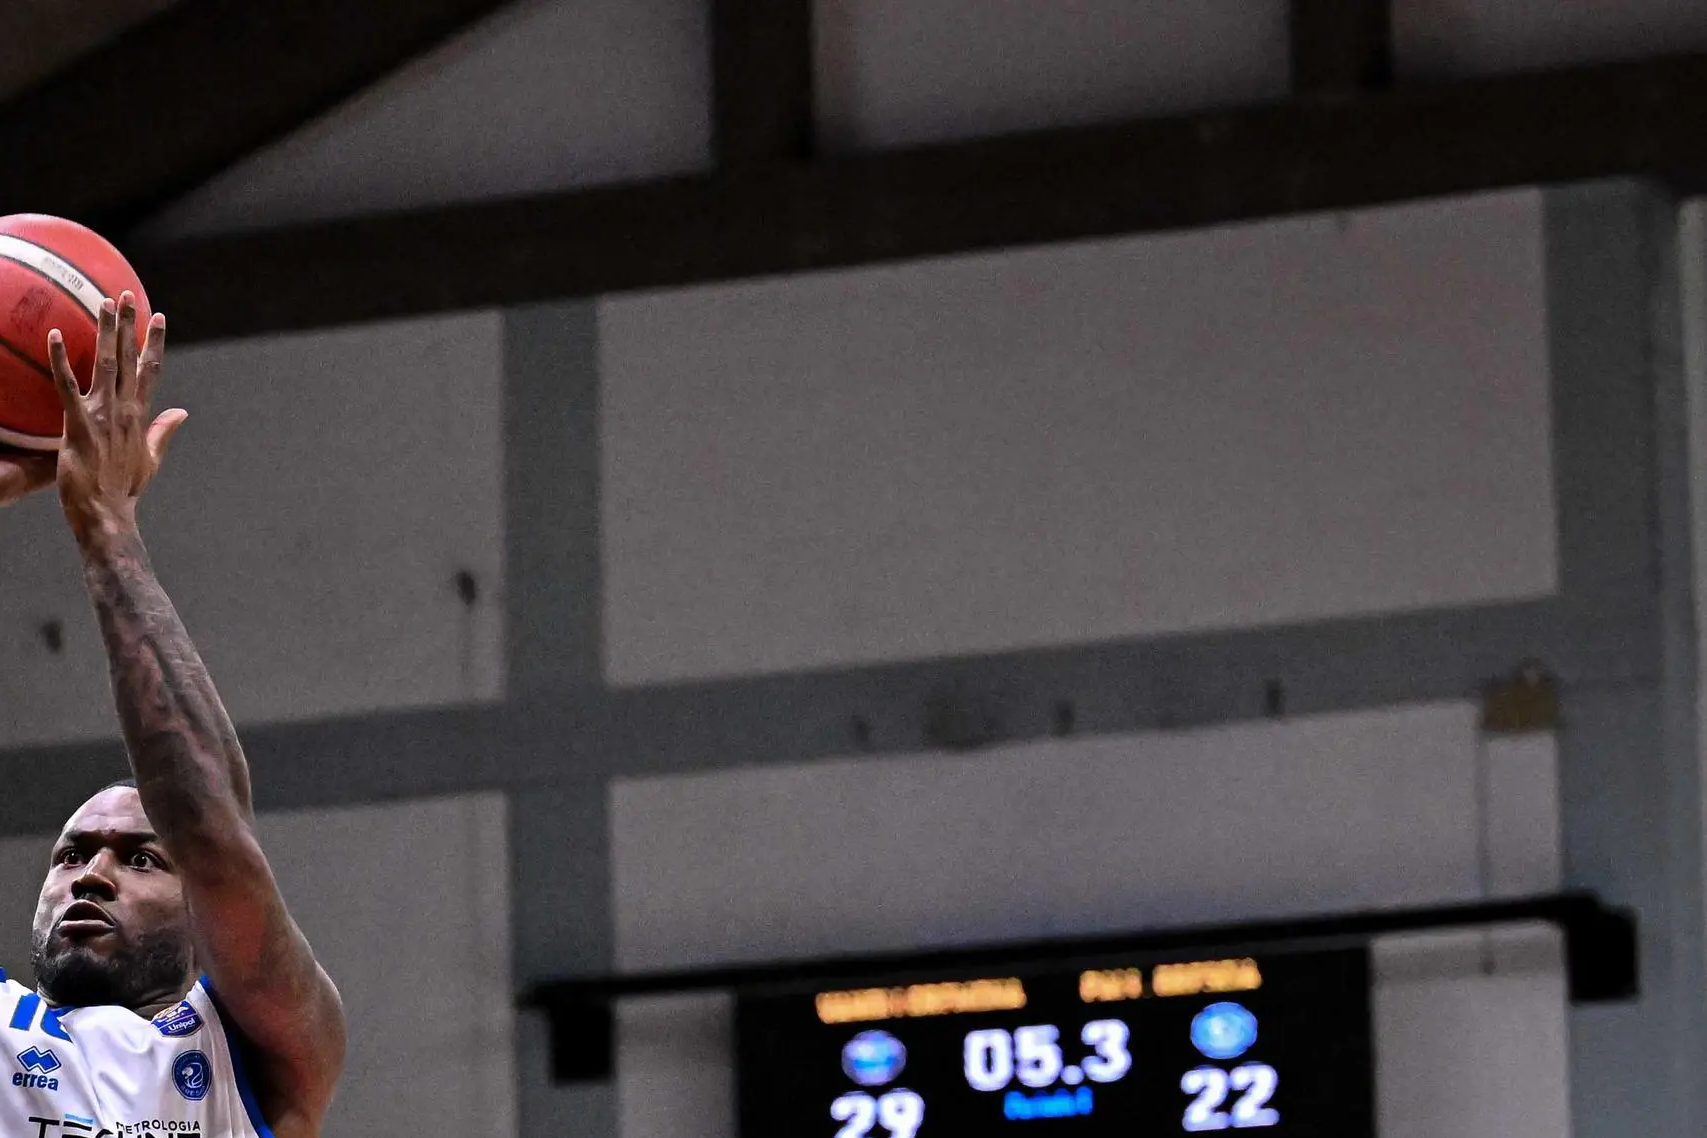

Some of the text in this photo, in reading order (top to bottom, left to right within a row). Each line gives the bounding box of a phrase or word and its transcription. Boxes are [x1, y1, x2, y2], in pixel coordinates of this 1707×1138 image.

[168, 1018, 195, 1032] Unipol
[963, 1018, 1132, 1091] 05.3
[1181, 1061, 1279, 1131] 22
